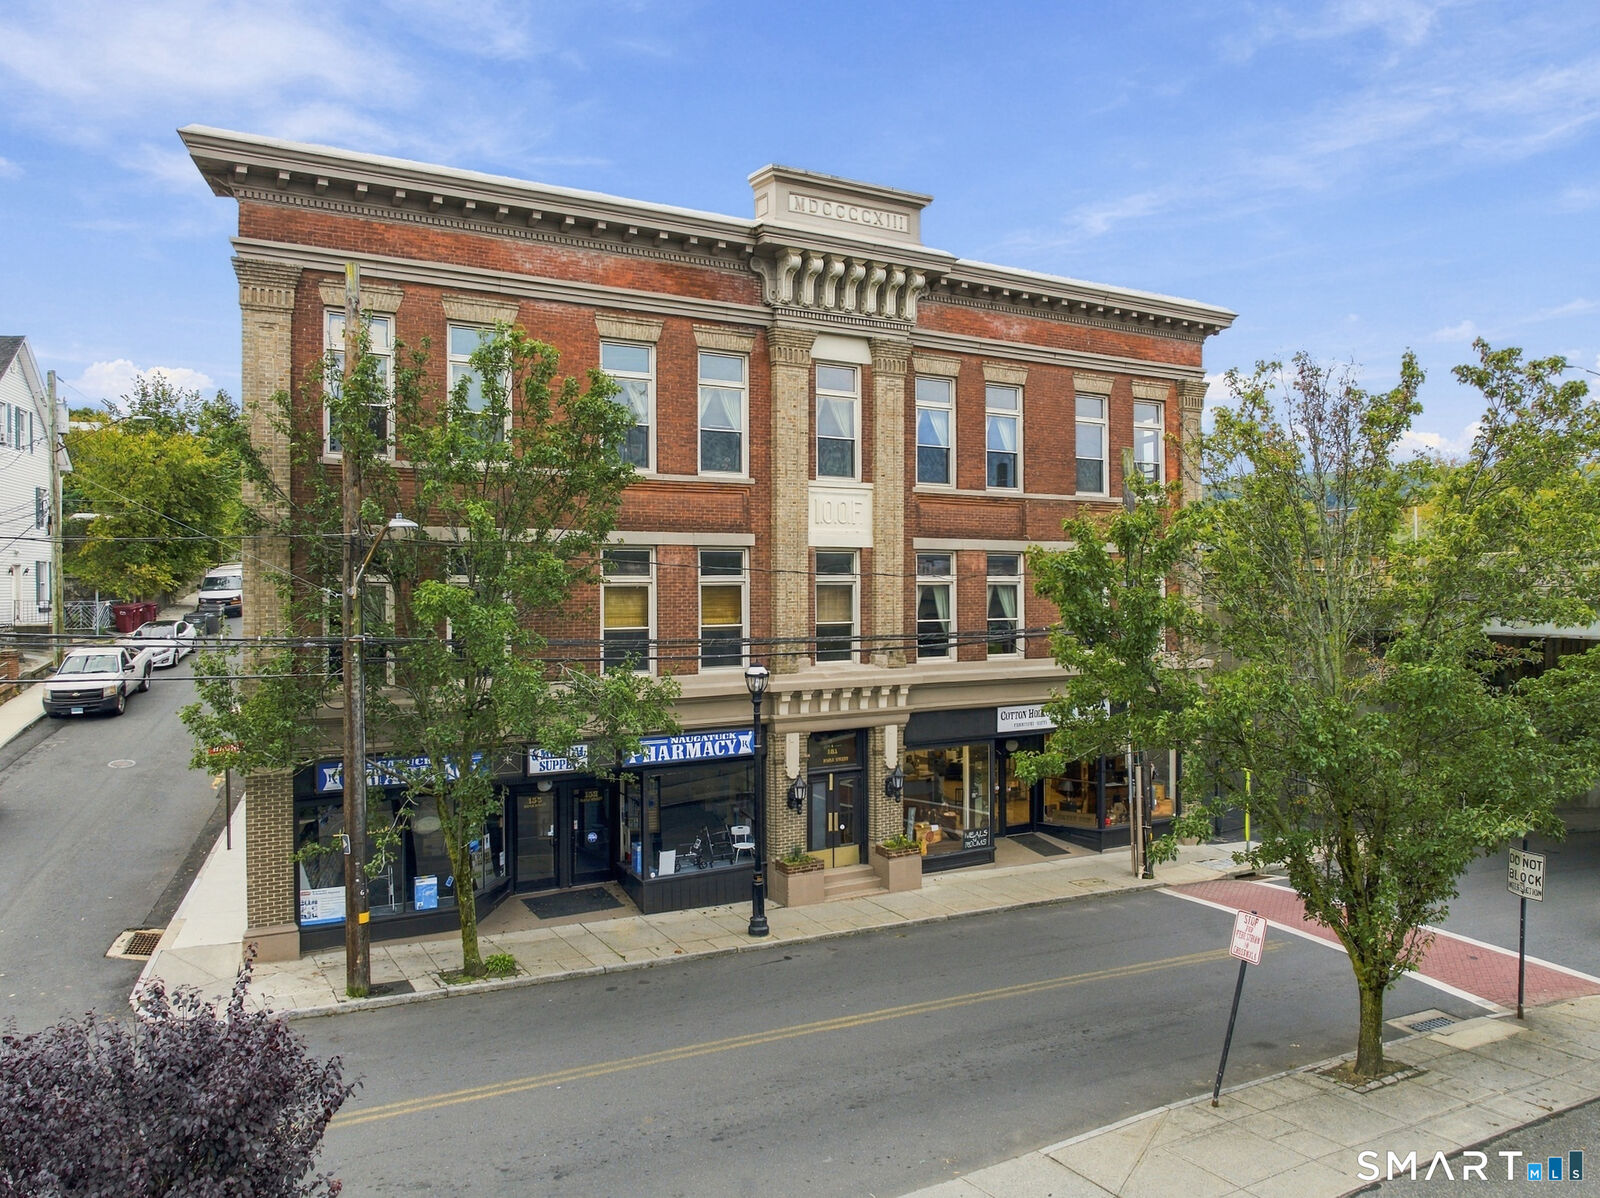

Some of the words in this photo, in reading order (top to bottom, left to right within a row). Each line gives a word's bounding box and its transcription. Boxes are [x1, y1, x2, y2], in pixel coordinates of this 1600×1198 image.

[794, 196, 903, 230] MDCCCCXIII
[1000, 710, 1027, 721] COTTON
[671, 732, 737, 744] NAUGATUCK
[539, 759, 578, 772] SUPPL
[964, 839, 987, 849] ROOMS
[1509, 853, 1520, 866] DO
[1522, 858, 1543, 872] NOT
[1509, 868, 1542, 887] BLOCK
[1243, 914, 1260, 927] STOP
